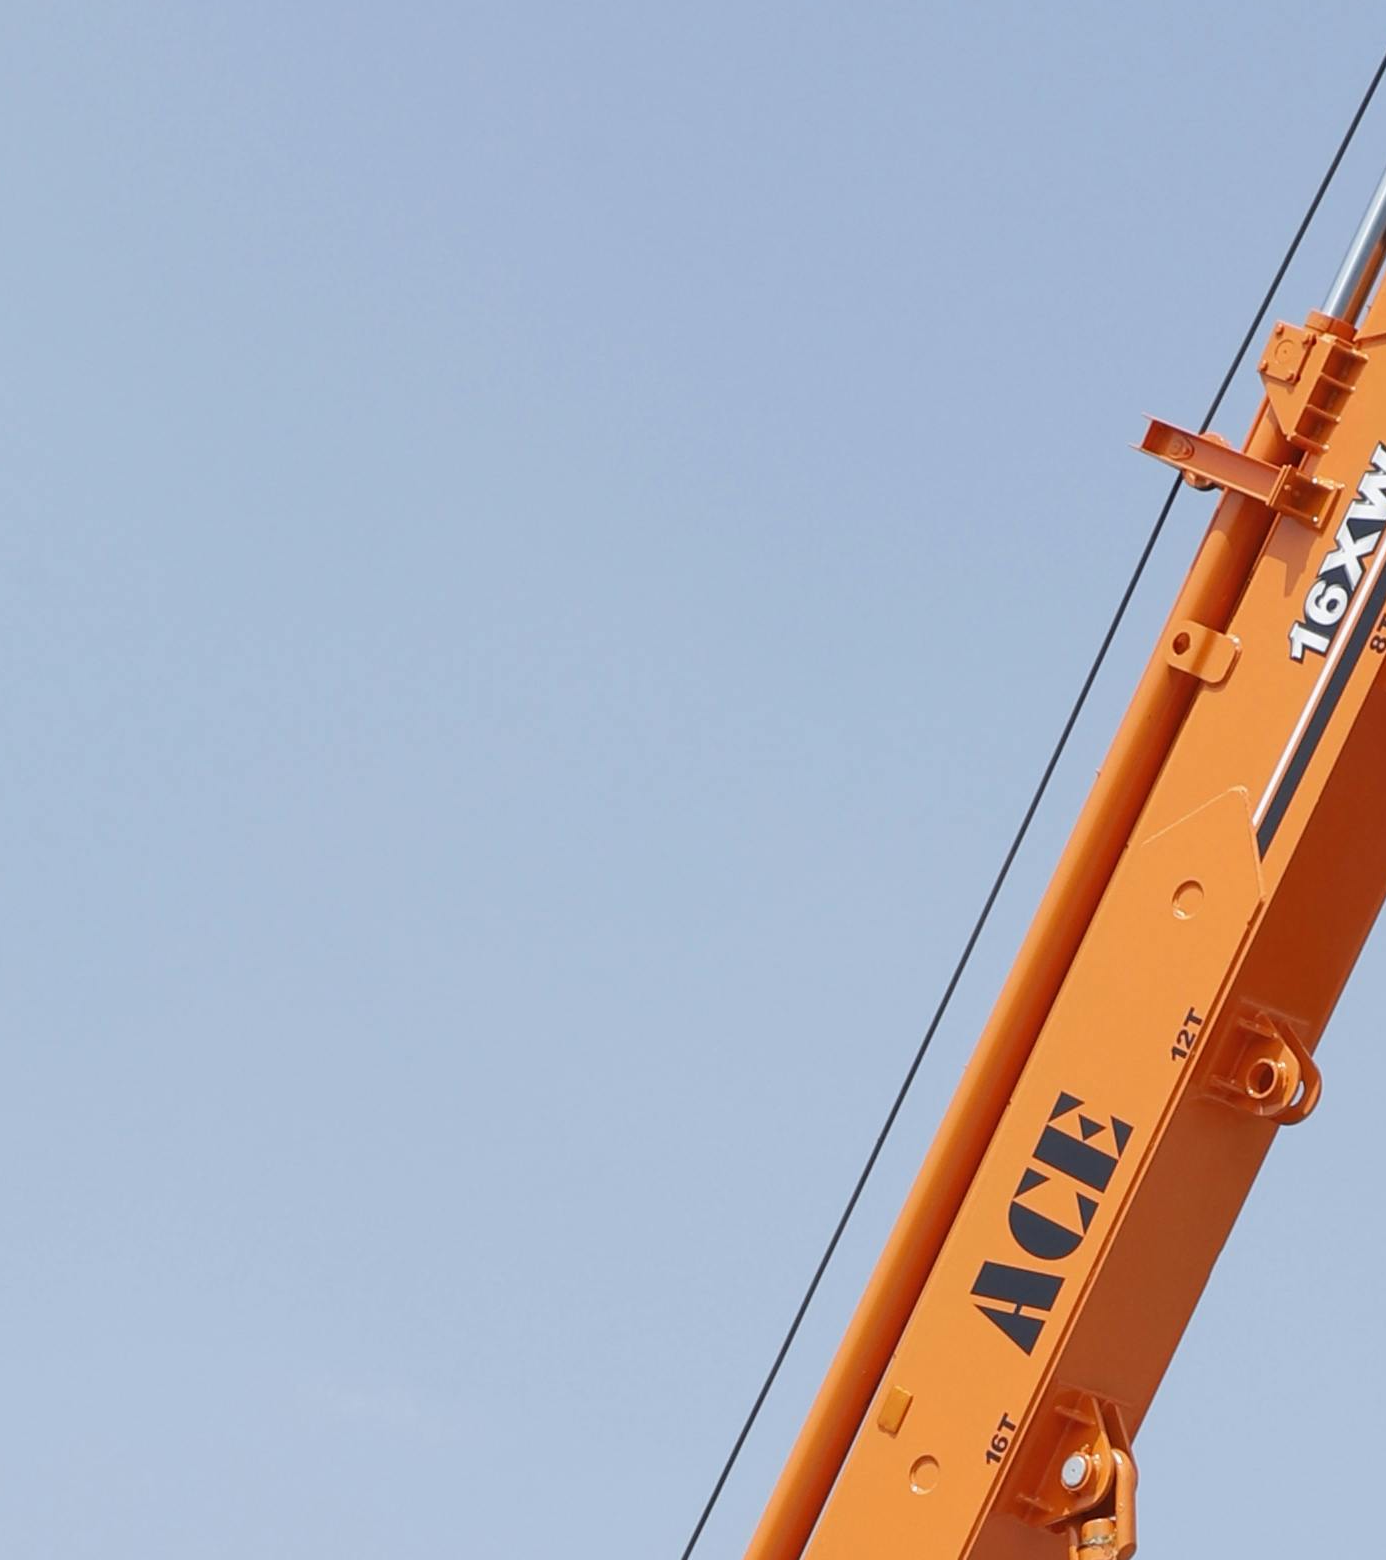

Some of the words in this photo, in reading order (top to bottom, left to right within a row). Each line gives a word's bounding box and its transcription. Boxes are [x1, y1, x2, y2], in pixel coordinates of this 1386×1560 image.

[1172, 1006, 1203, 1061] 12T
[970, 1091, 1134, 1356] ACE
[986, 1412, 1016, 1465] 16T
